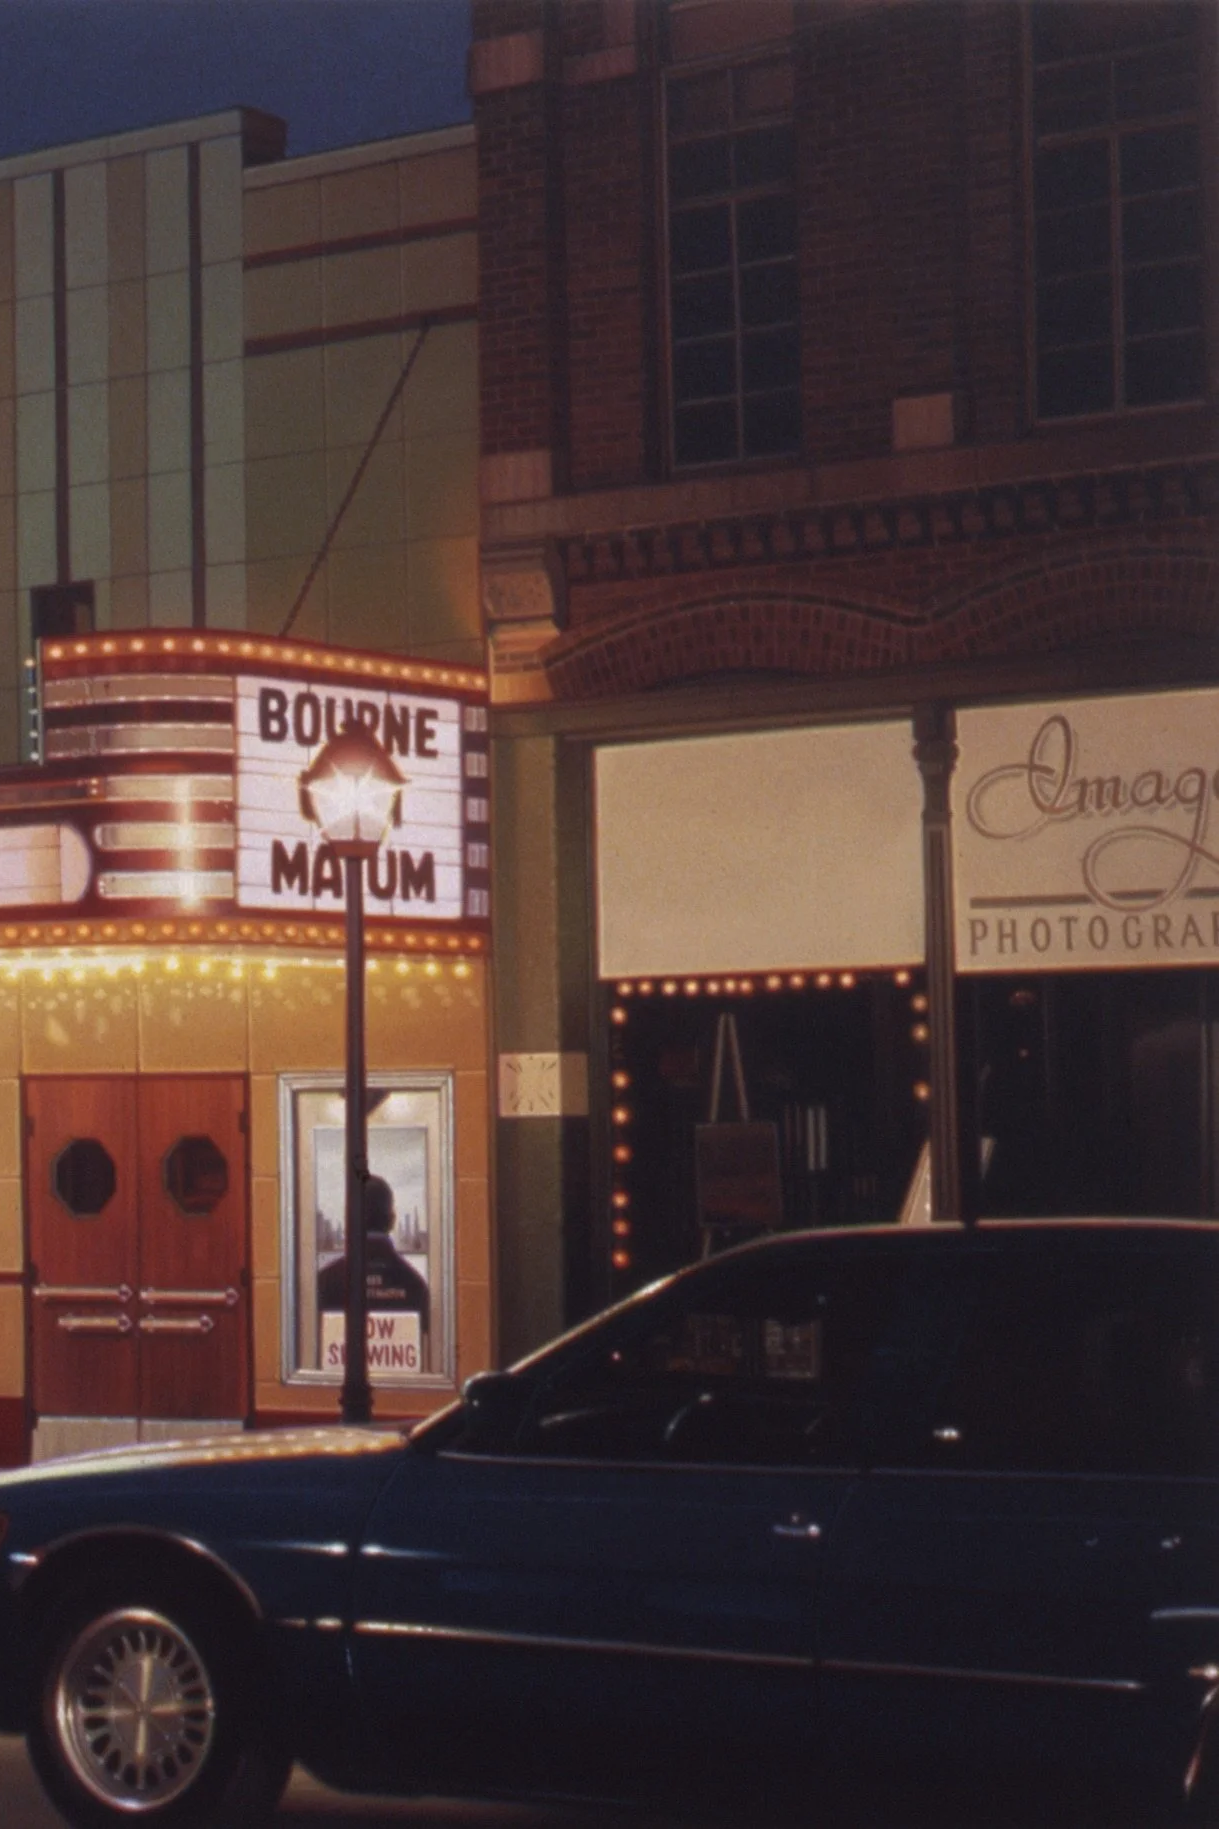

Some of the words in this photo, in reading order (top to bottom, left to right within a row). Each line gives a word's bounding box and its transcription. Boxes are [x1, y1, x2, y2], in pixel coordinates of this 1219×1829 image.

[967, 714, 1219, 912] Imag
[271, 839, 436, 903] MAUM
[366, 1317, 395, 1340] OW
